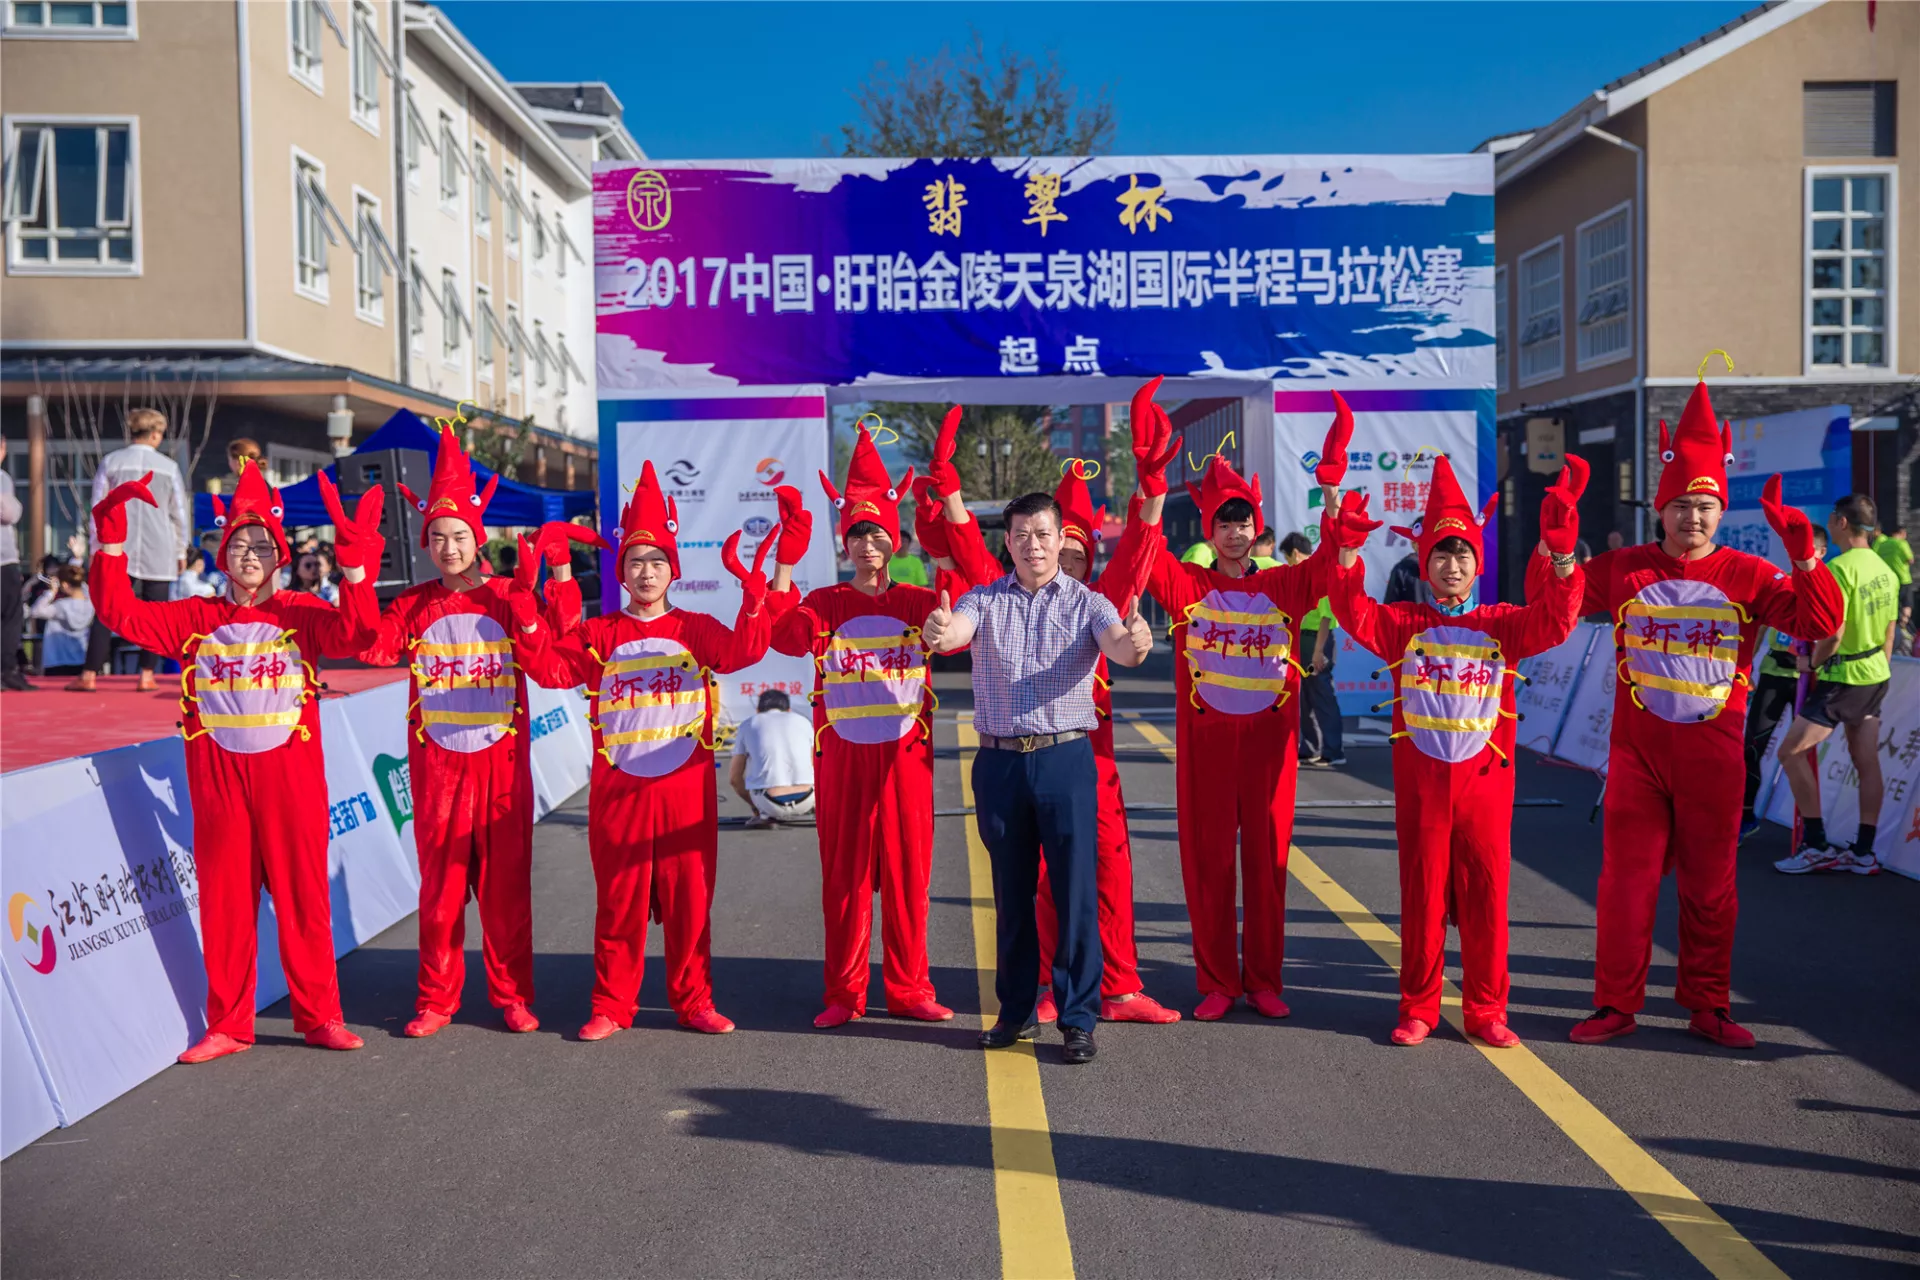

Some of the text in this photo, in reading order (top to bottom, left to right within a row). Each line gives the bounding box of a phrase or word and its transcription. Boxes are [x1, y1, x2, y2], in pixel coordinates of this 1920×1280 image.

[922, 172, 1173, 238] 翡翠杯
[999, 334, 1099, 374] 起点
[1347, 451, 1373, 463] 移动
[1203, 621, 1272, 666] 虾神
[1640, 616, 1722, 661] 虾神
[209, 653, 288, 694] 虾神
[428, 655, 502, 695] 虾神
[840, 645, 912, 684] 虾神
[1416, 656, 1492, 704] 虾神
[609, 666, 683, 709] 虾神
[68, 926, 114, 961] JIANGSU
[113, 917, 142, 942] XUYI
